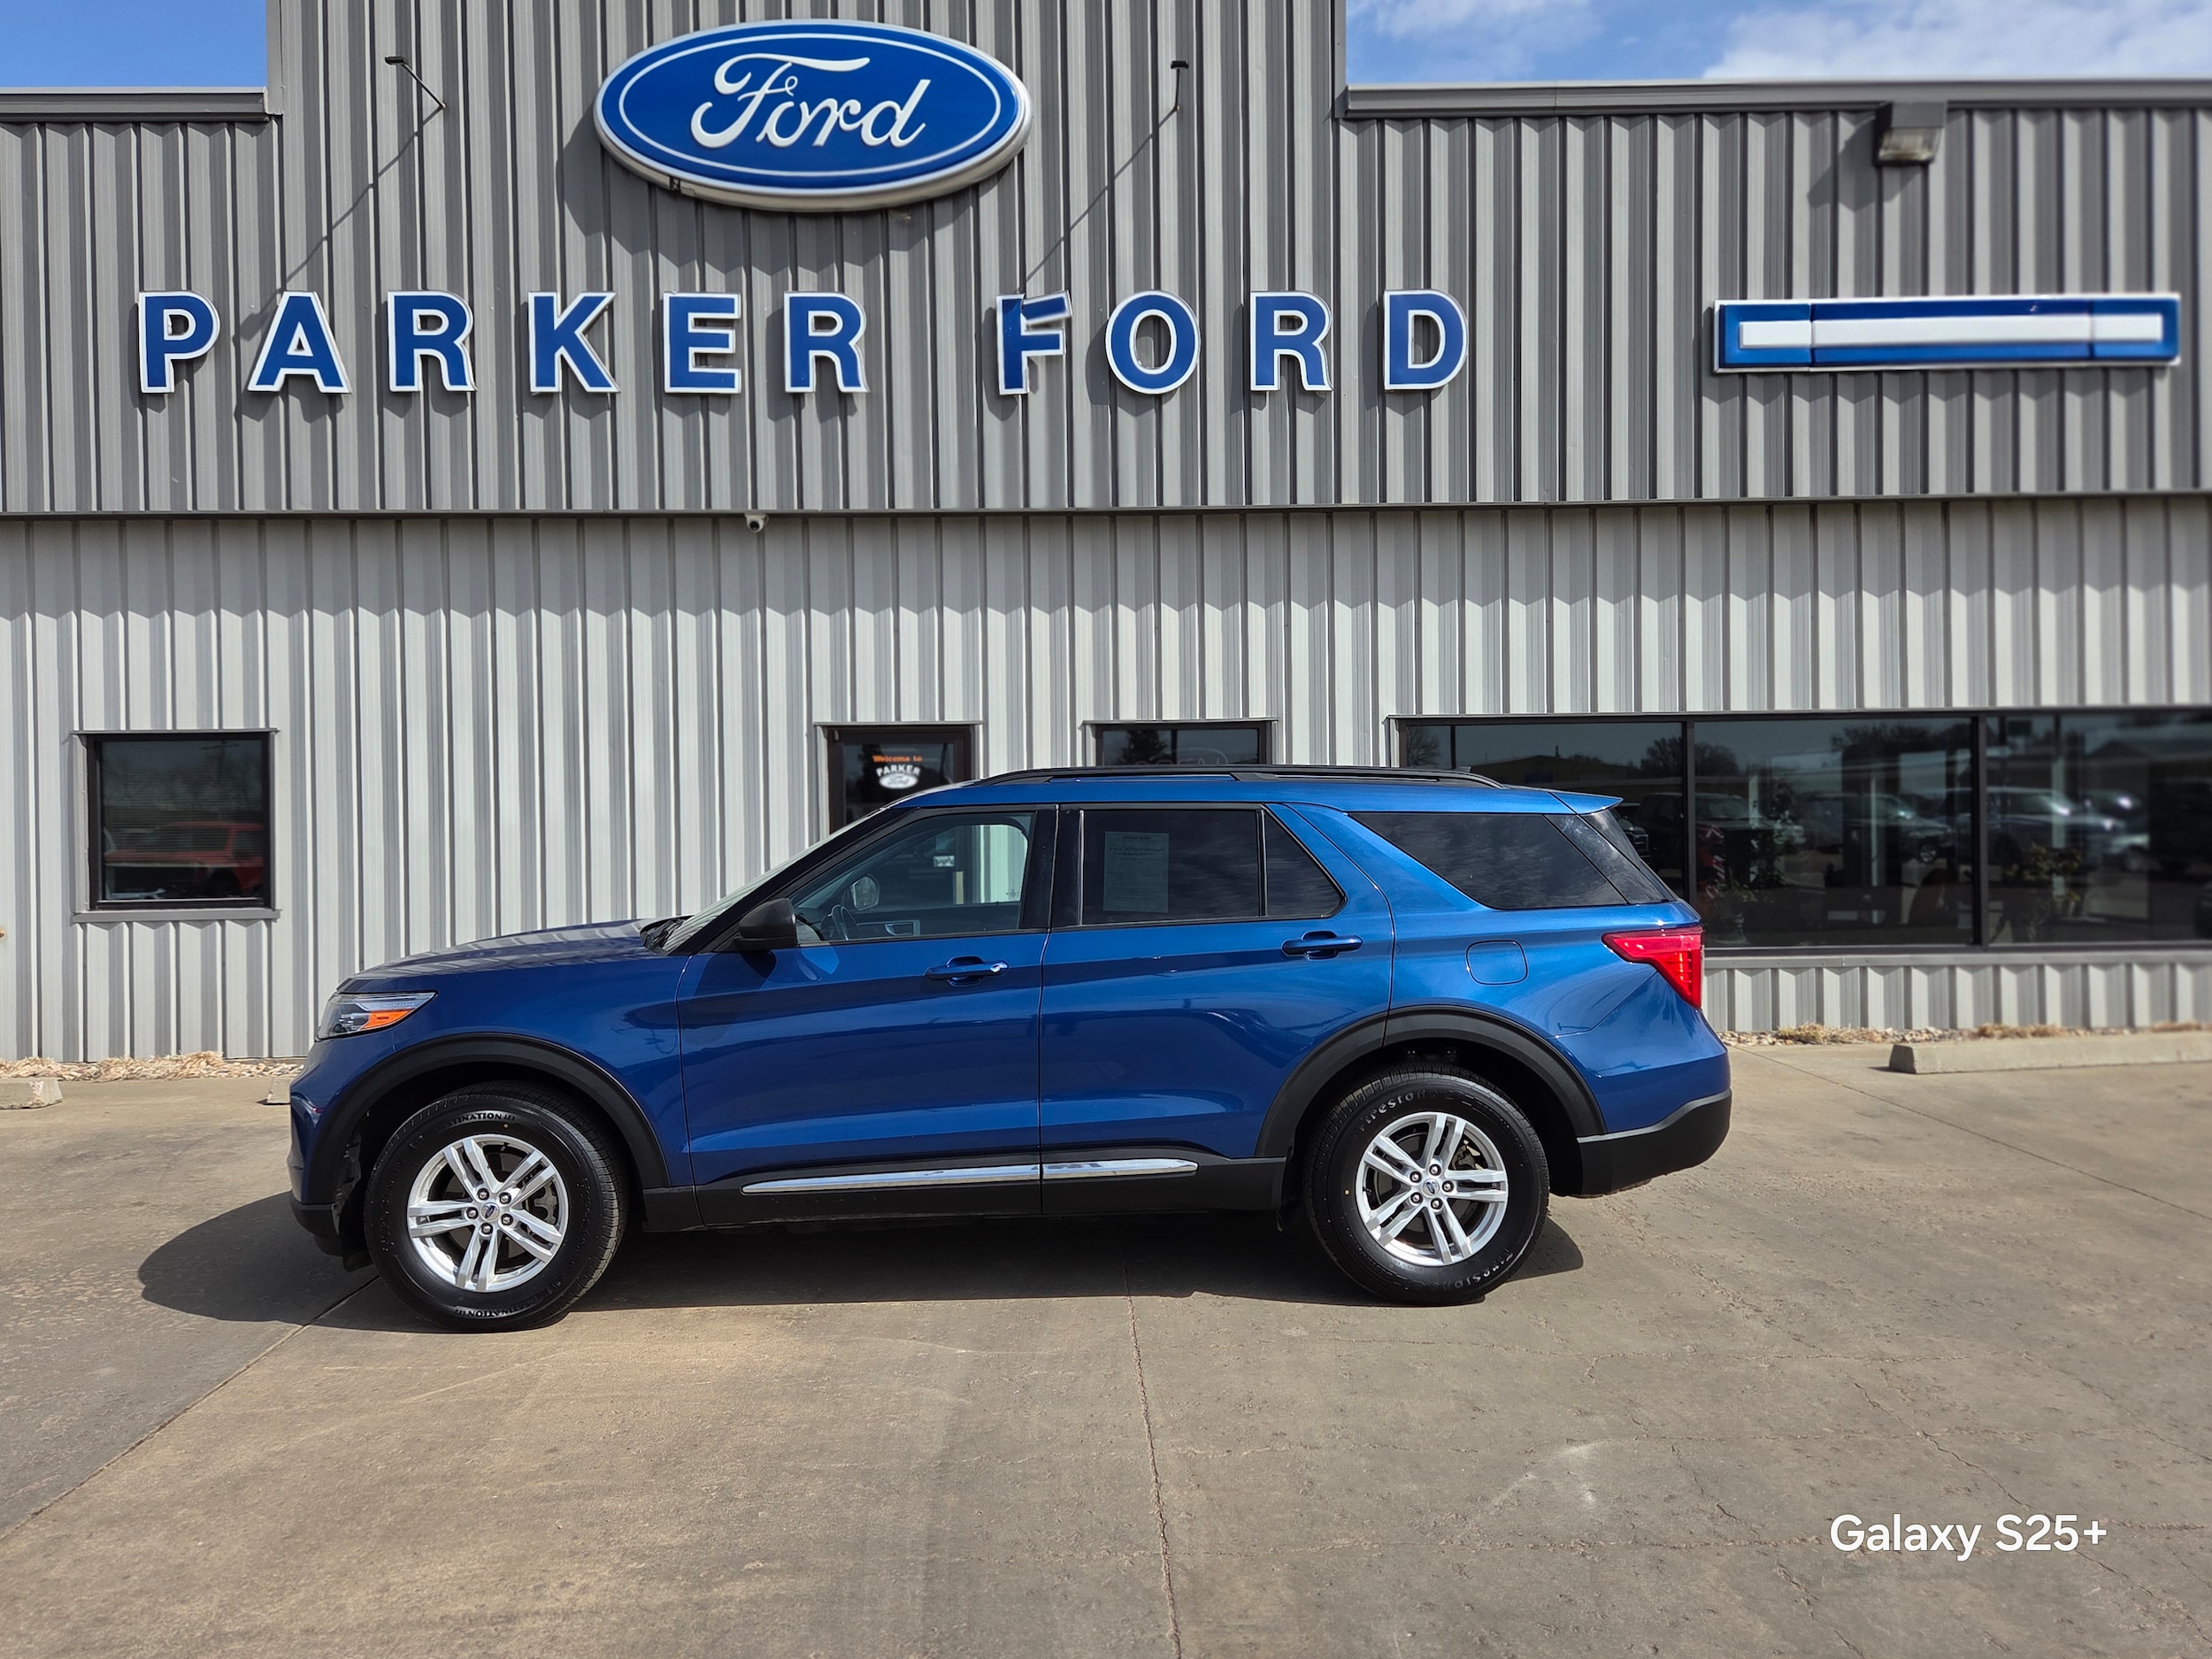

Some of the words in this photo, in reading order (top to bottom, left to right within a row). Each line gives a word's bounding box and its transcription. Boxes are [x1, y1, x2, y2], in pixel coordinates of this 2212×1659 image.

[690, 53, 932, 149] Ford
[138, 289, 869, 395] PARKER
[996, 289, 1469, 395] FORD
[876, 764, 920, 777] PARKER
